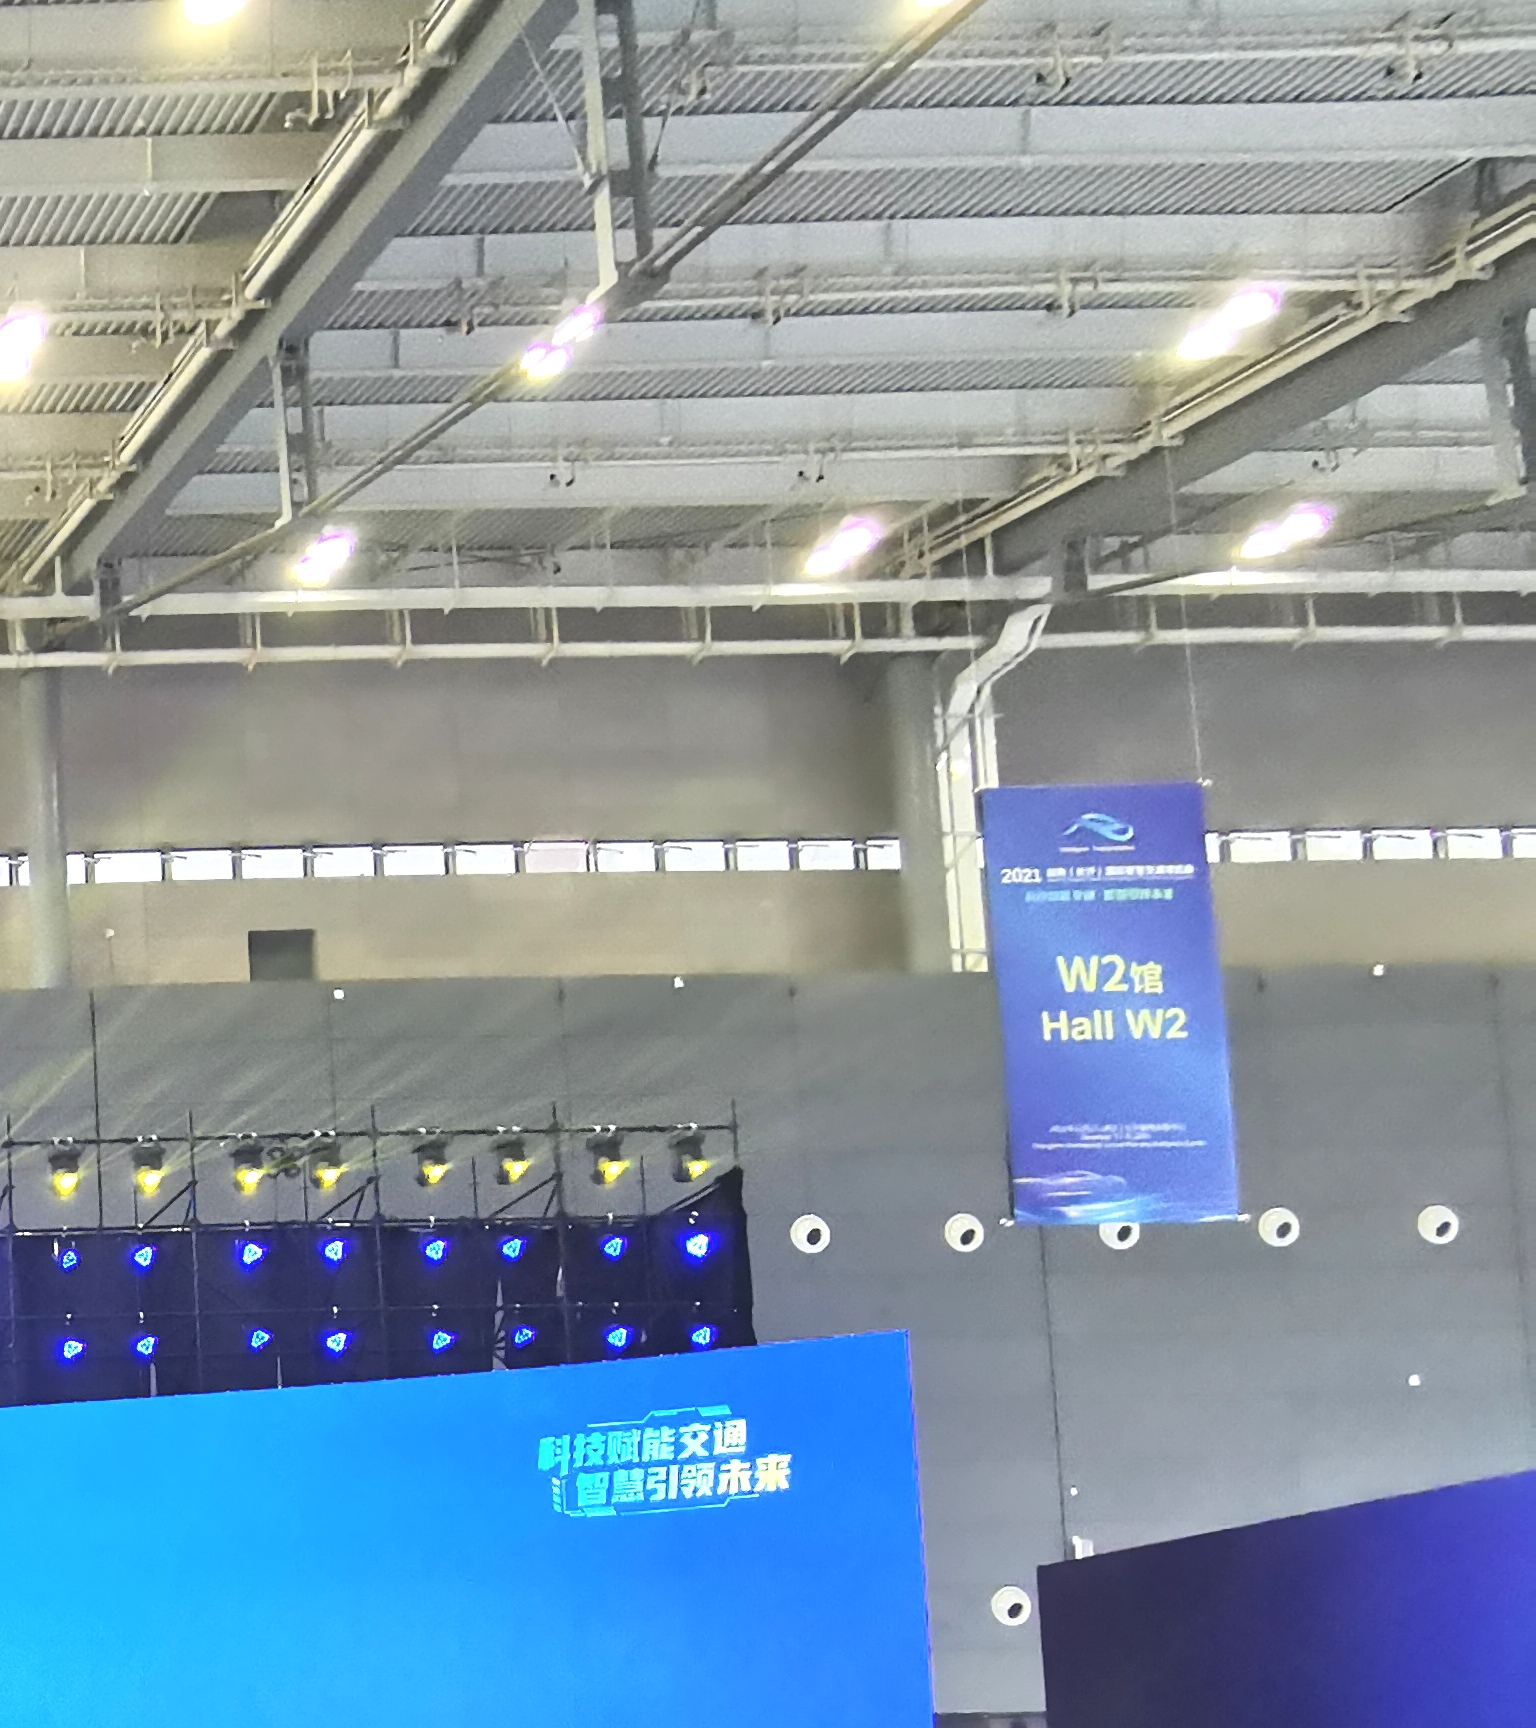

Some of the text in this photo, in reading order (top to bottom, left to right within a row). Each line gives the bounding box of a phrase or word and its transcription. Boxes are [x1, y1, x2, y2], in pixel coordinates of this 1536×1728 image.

[1001, 866, 1043, 884] 2021
[1056, 953, 1165, 995] W2馆
[1040, 1007, 1189, 1042] Hall W2
[537, 1417, 747, 1477] 科技赋能交通
[575, 1452, 793, 1508] 智慧引领未来
